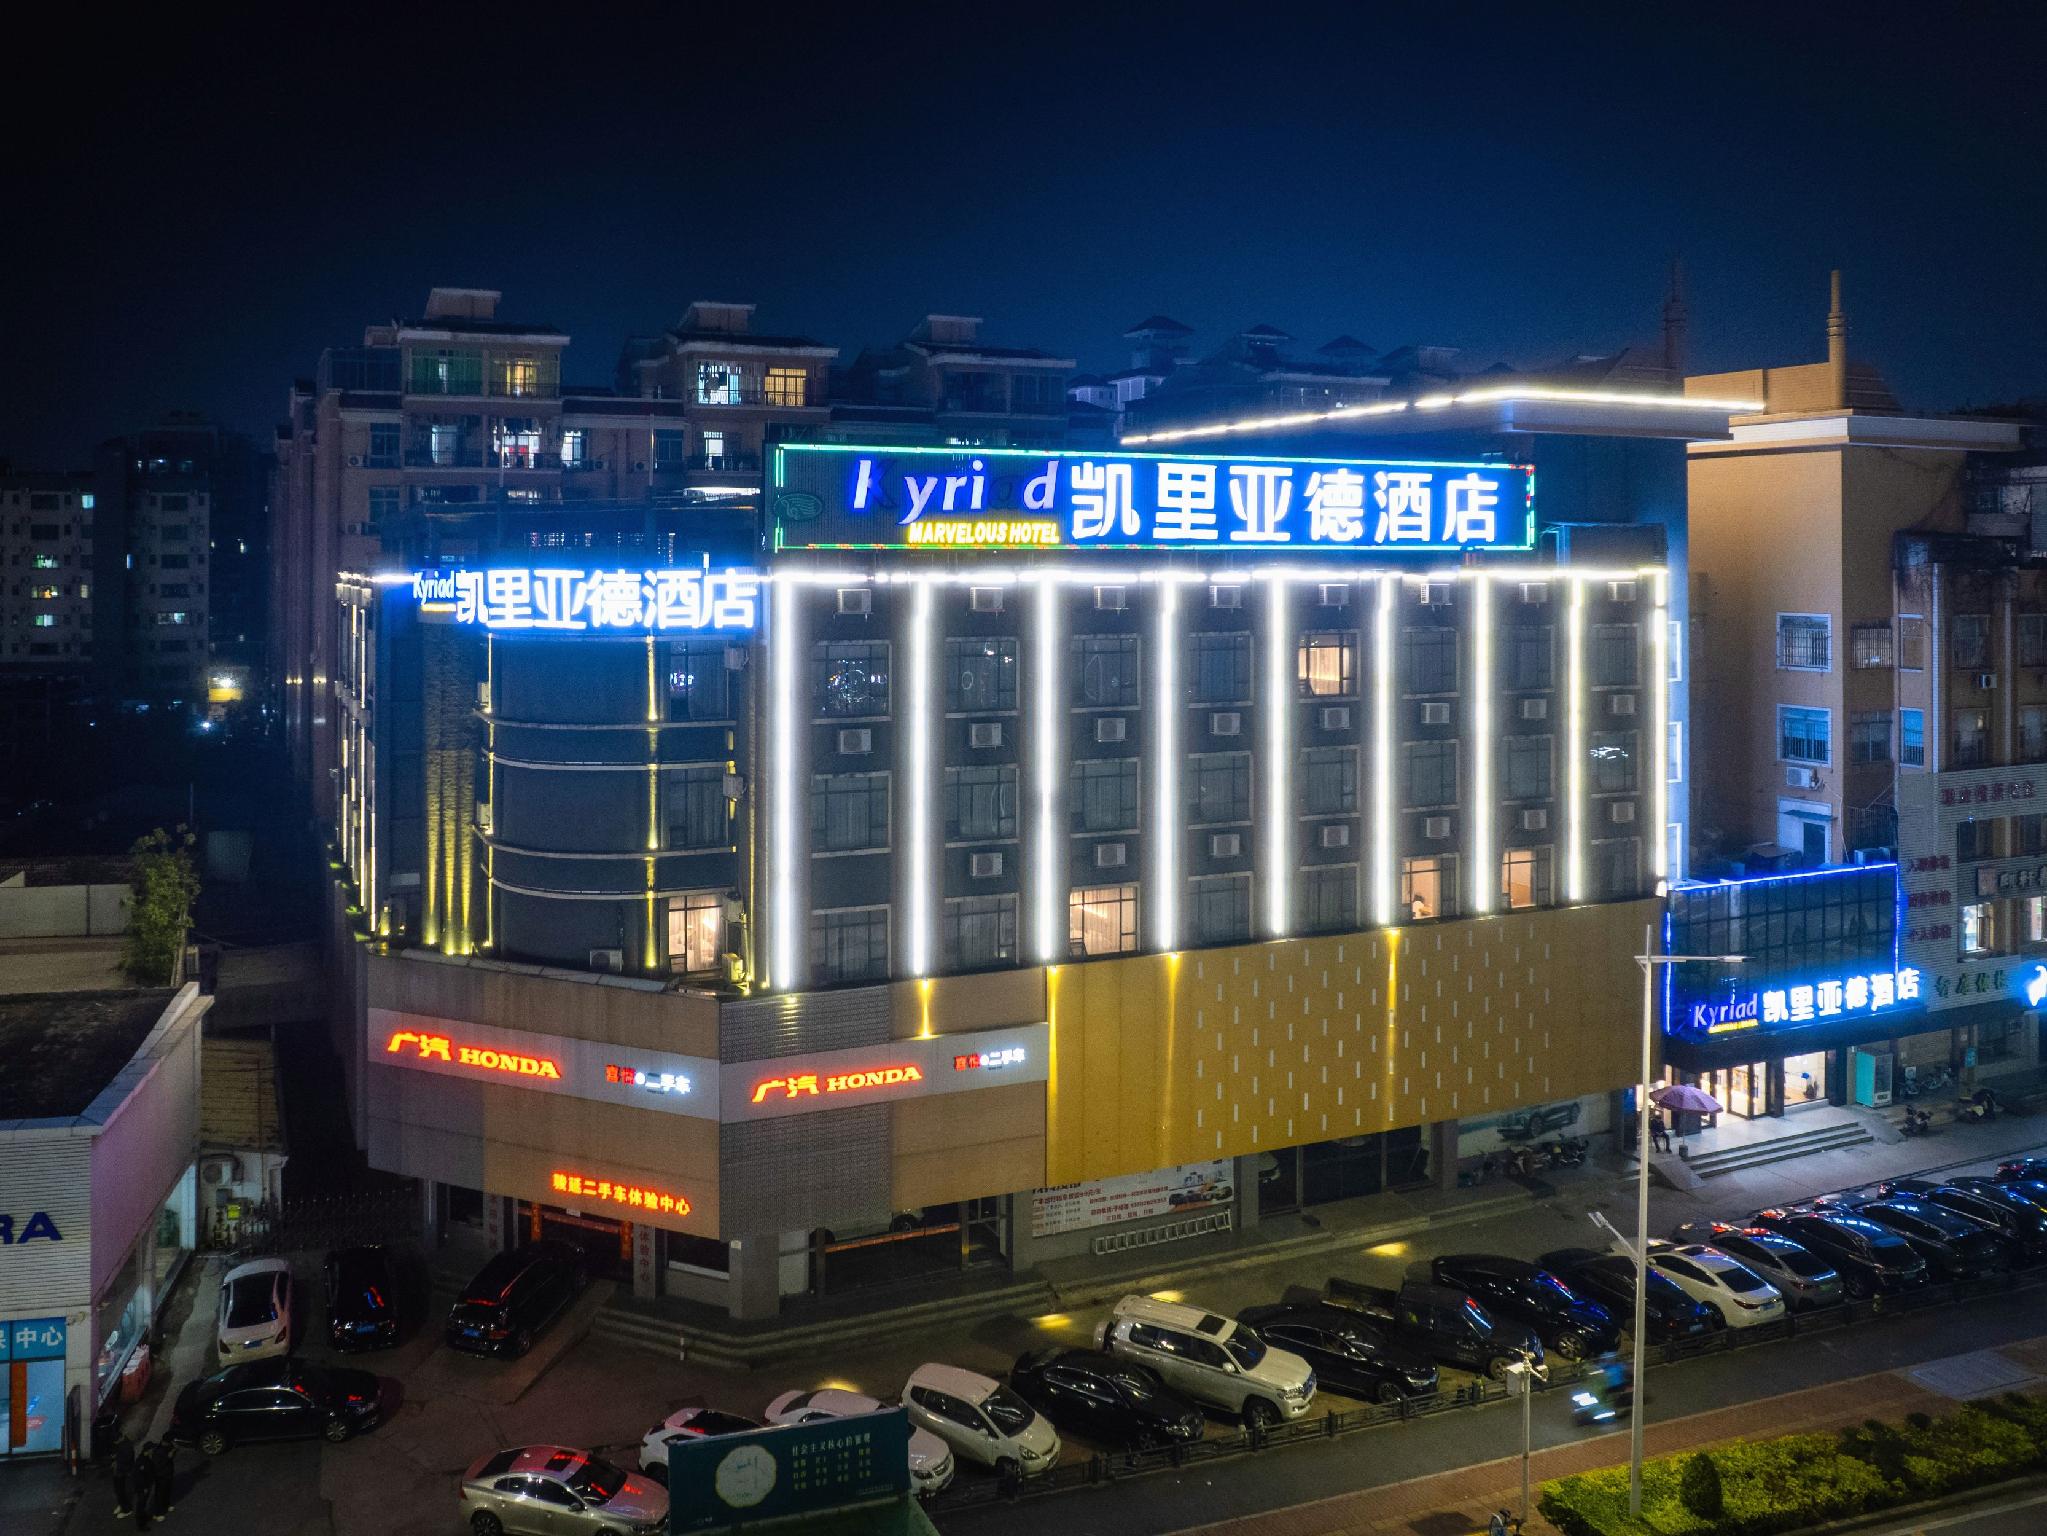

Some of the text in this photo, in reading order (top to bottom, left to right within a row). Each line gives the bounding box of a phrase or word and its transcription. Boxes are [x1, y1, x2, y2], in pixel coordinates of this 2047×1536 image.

[1071, 461, 1499, 544] 凯里亚德酒店
[908, 522, 1060, 544] MARVELOUS HOTEL
[412, 568, 757, 630] Kyriad 凯里亚德酒店
[1693, 993, 1758, 1028] Kyriad
[1763, 967, 1920, 1023] 凯里亚德酒店
[459, 1047, 562, 1080] HONDA
[826, 1066, 923, 1093] HONDA
[0, 1327, 63, 1351] 中心
